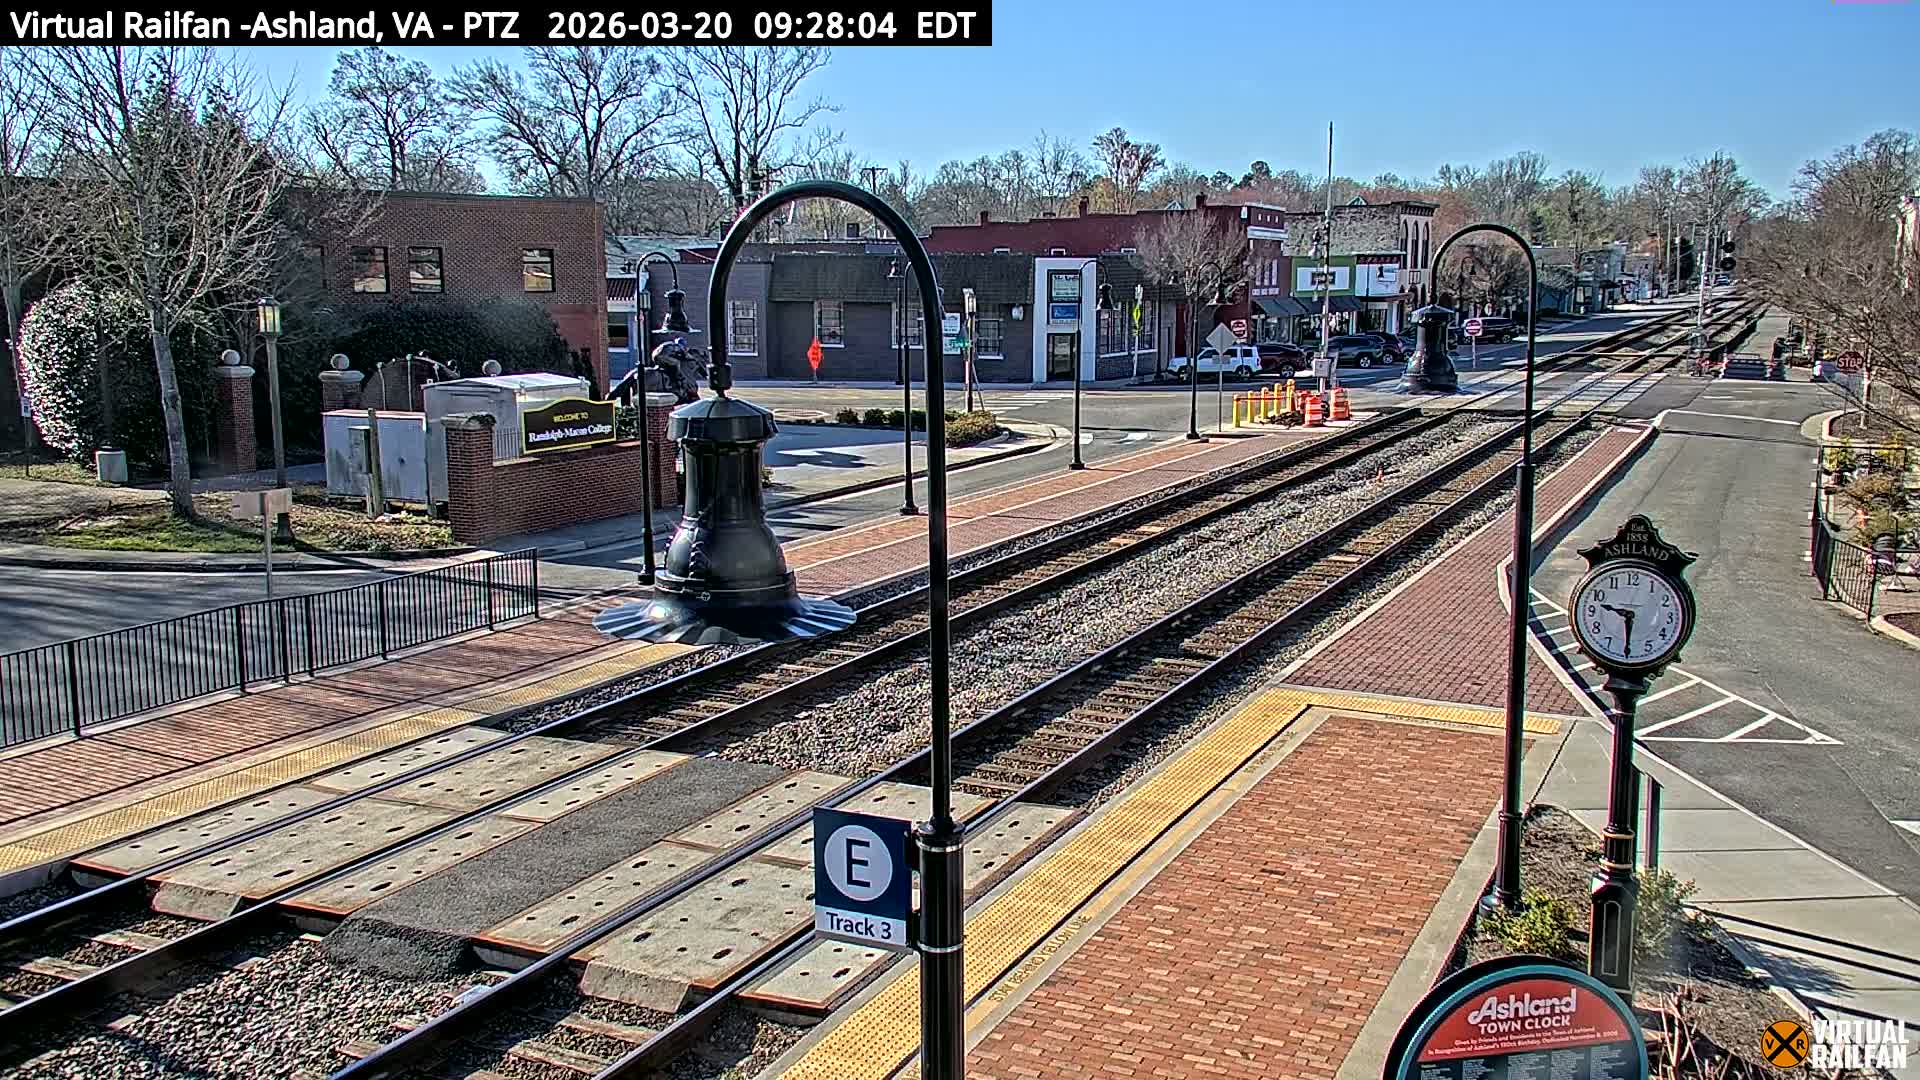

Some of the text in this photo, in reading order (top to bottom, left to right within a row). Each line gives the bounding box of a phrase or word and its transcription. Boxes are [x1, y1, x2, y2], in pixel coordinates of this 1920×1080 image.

[1838, 357, 1863, 368] STOP
[553, 413, 580, 422] WELCOME
[528, 424, 612, 442] Randolph-Macon College
[1604, 543, 1670, 561] ASHLAND
[1609, 577, 1619, 589] 11
[1626, 573, 1640, 586] 12
[1649, 581, 1655, 593] 1
[1593, 589, 1605, 602] 10
[1662, 595, 1670, 607] 2
[1588, 605, 1596, 617] 9
[1666, 612, 1674, 625] 3
[1592, 622, 1601, 634] 8
[1658, 627, 1667, 640] 4
[1604, 637, 1613, 648] 7
[1644, 640, 1653, 652] 5
[846, 838, 872, 888] E
[826, 911, 892, 939] Track 3
[1467, 988, 1577, 1025] Ashland
[1478, 1015, 1571, 1034] TOWN CLOCK
